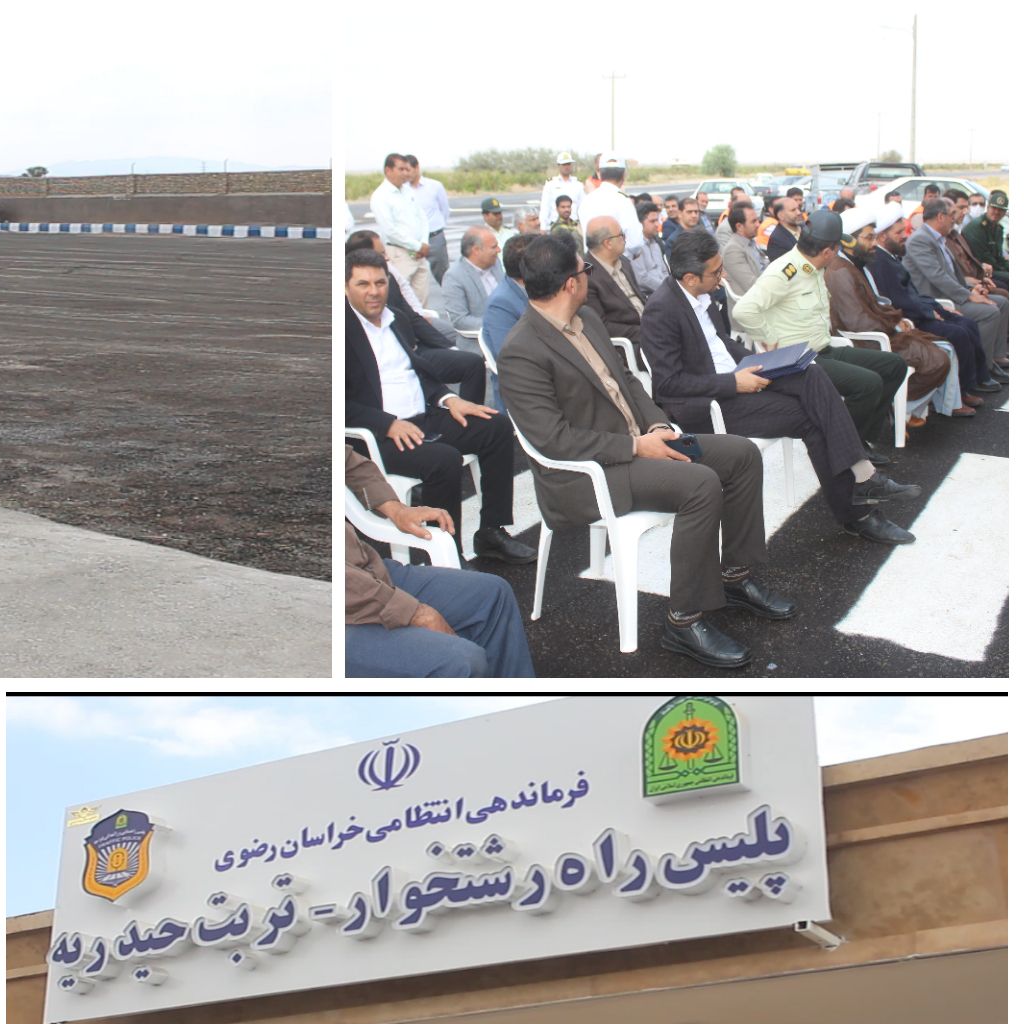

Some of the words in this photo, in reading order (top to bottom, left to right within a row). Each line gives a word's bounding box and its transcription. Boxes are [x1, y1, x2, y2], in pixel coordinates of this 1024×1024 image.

[364, 796, 465, 843] انتظامی
[465, 769, 590, 824] فرماندهی
[213, 838, 278, 873] رضوی
[279, 815, 364, 859] خراسان
[559, 831, 649, 894] راه
[662, 807, 792, 896] پلیس
[341, 832, 547, 934] رشتخوار
[195, 872, 296, 965] تربت
[49, 919, 188, 989] حیدریه
